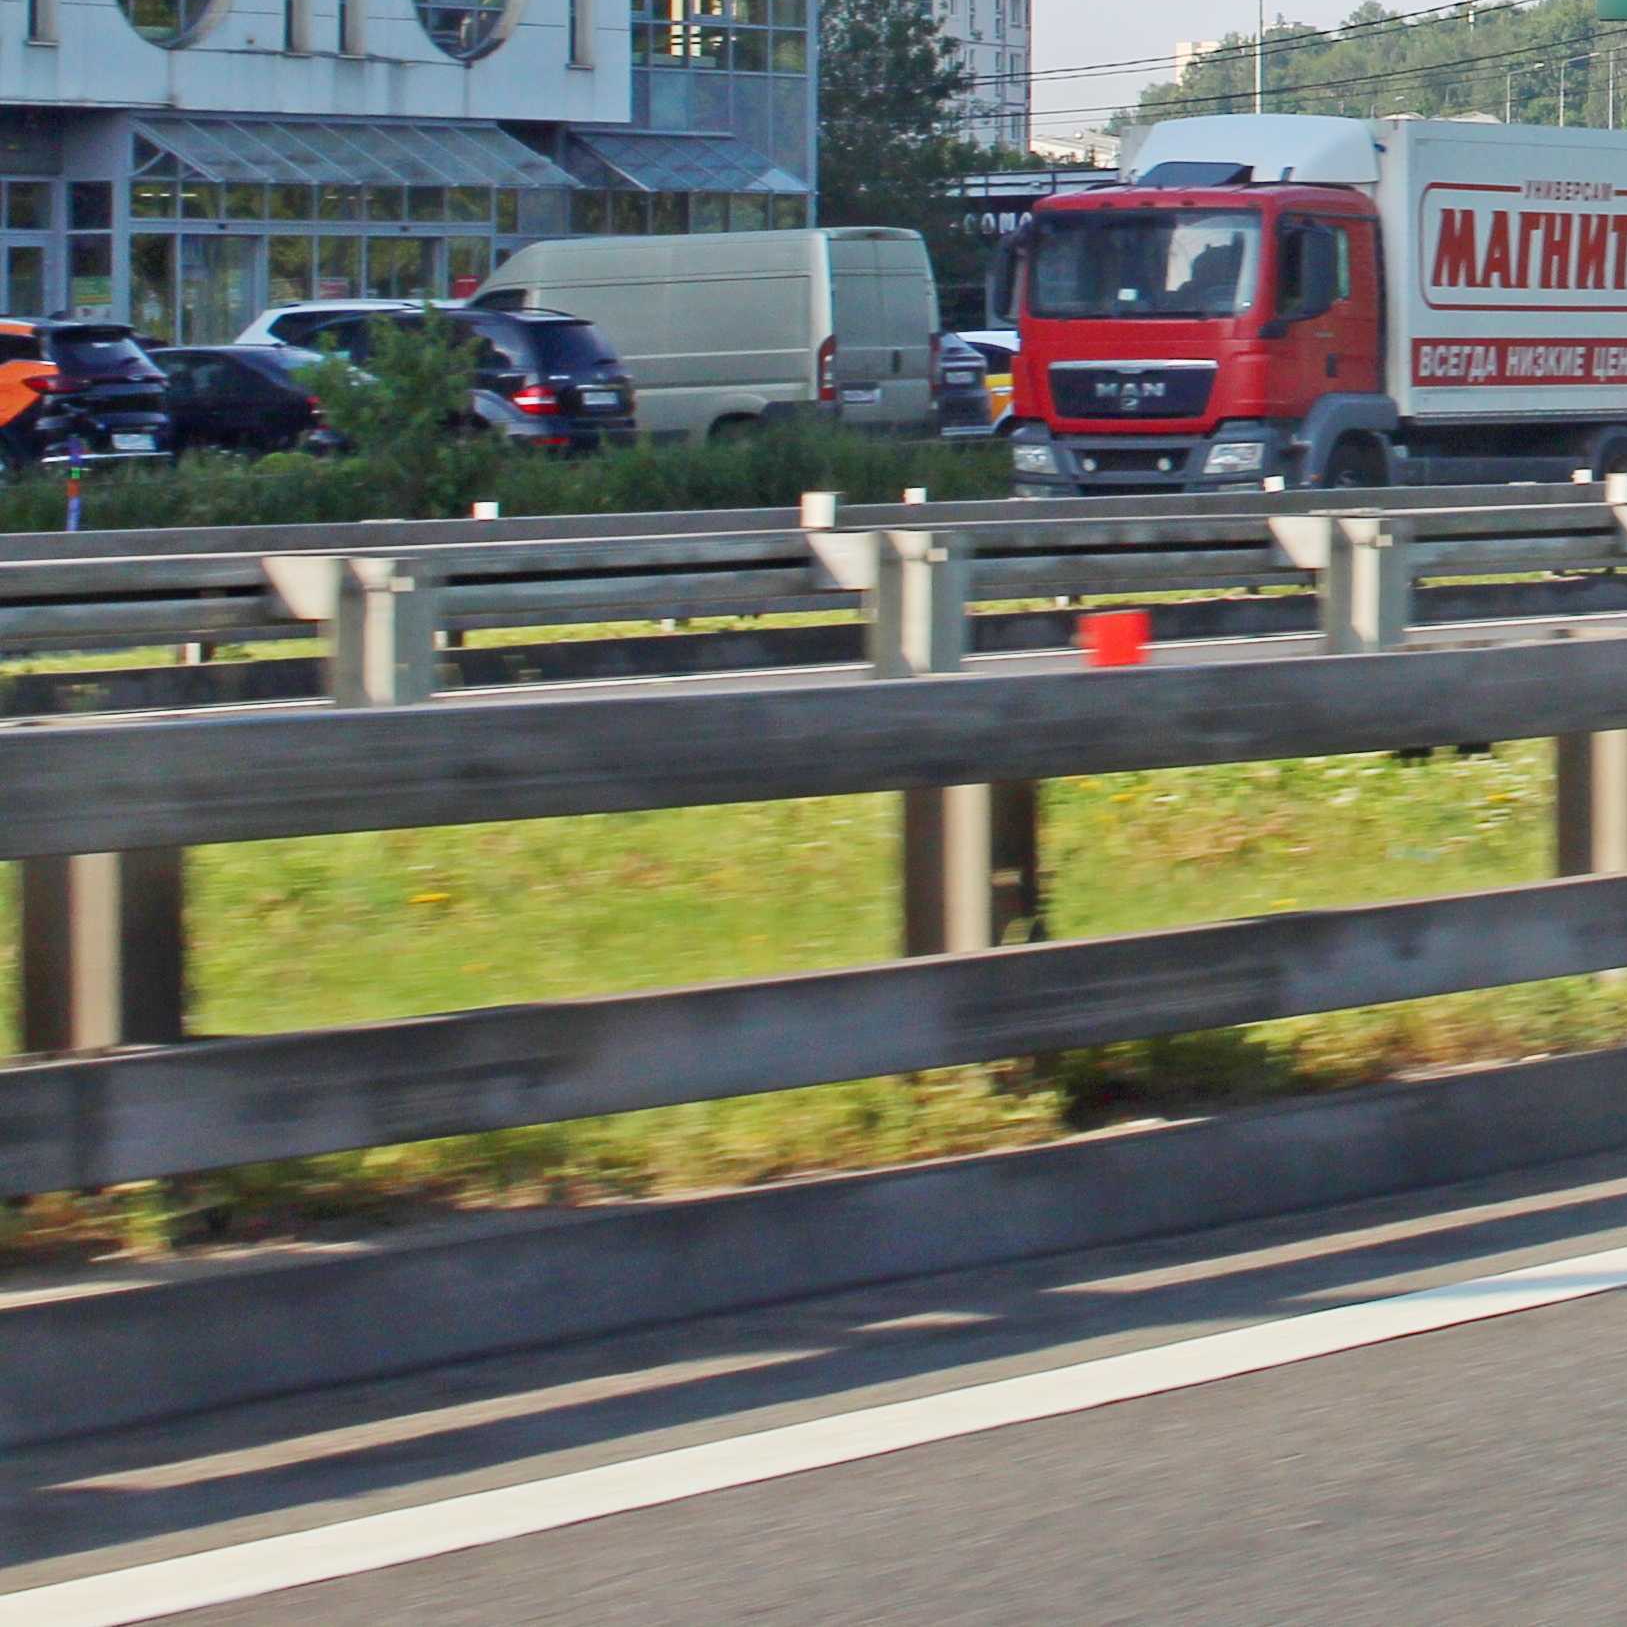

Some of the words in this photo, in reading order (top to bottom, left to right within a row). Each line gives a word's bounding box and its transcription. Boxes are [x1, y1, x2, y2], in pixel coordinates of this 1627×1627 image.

[1418, 345, 1498, 382] ВСЕГДА
[1505, 346, 1586, 377] НИЗКИЕ
[1095, 382, 1167, 398] MAN
